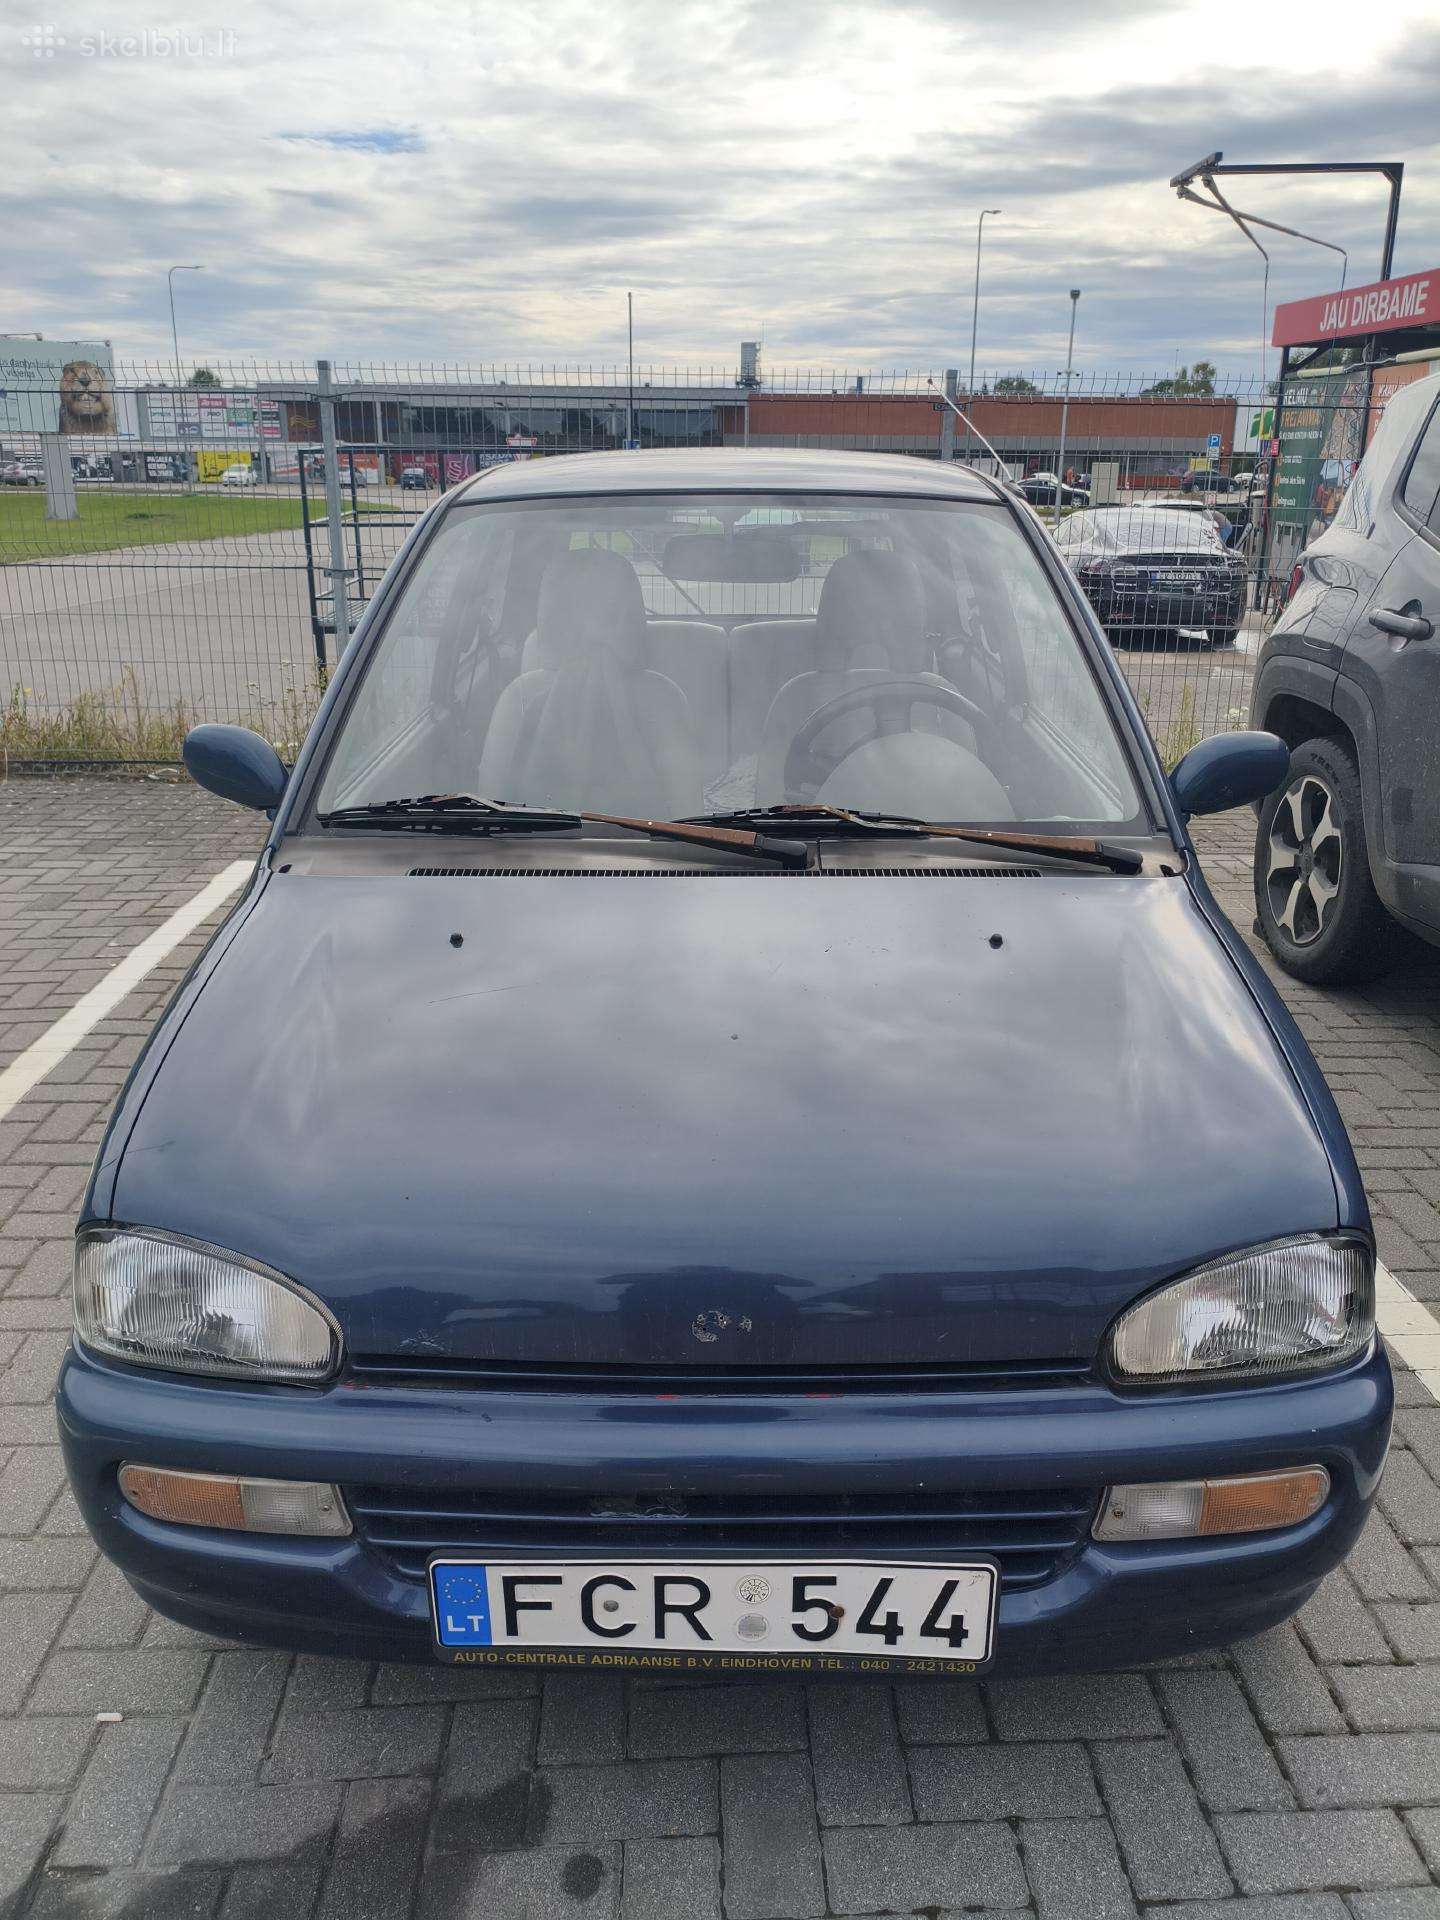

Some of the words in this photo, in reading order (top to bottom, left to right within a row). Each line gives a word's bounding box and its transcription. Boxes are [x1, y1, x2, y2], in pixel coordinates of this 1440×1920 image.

[1320, 298, 1349, 332] JAU
[1351, 280, 1430, 327] DIRBAME
[446, 1615, 484, 1633] LT
[502, 1574, 714, 1641] FCR
[792, 1575, 969, 1648] 544
[454, 1652, 586, 1666] AUTO-CENTRALE
[591, 1655, 681, 1668] ADRIAANSE
[721, 1658, 812, 1670] EINDHOVEN
[860, 1660, 889, 1671] 040
[907, 1661, 976, 1673] 2421430
